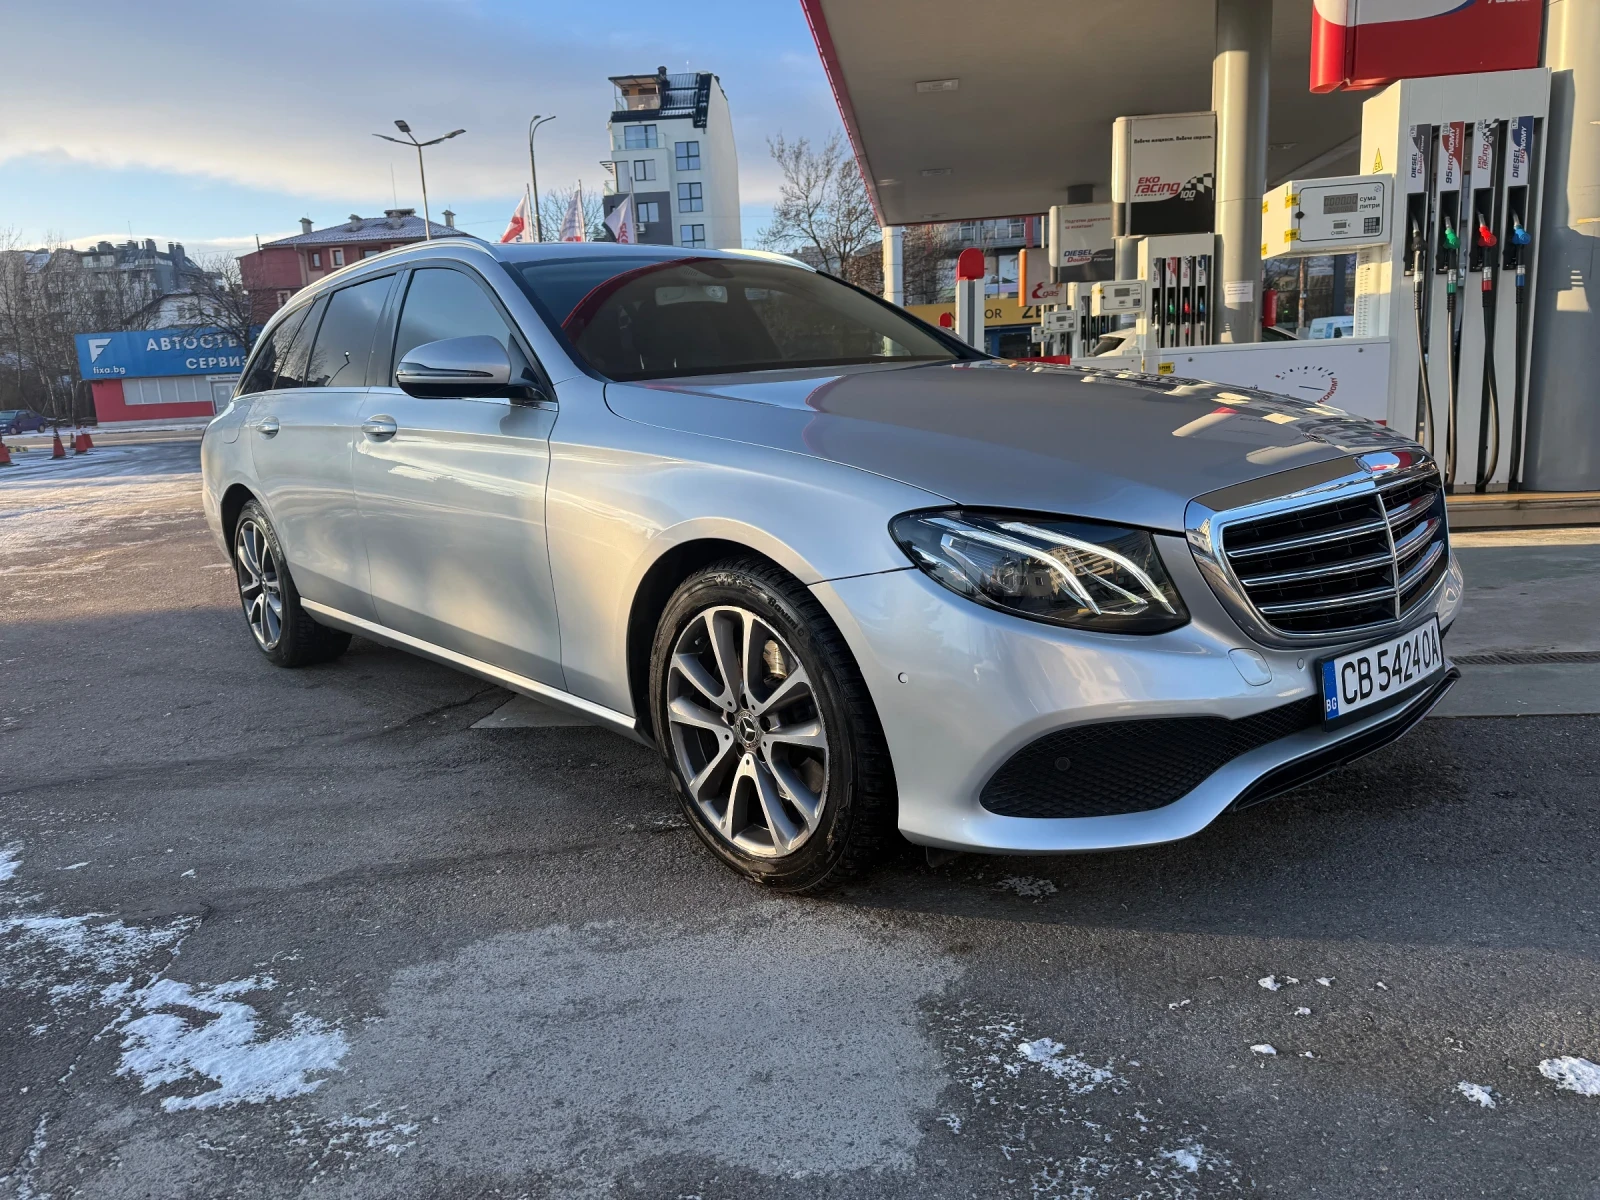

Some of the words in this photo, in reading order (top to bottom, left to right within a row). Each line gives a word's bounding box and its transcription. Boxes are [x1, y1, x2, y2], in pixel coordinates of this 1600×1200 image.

[1448, 127, 1456, 171] EKONOMY
[1482, 144, 1490, 170] racing
[1512, 148, 1520, 178] DIESEL
[1138, 176, 1160, 184] EKO
[1446, 171, 1453, 184] 95
[1135, 182, 1181, 195] racing
[1180, 190, 1196, 199] 100
[1359, 195, 1377, 203] сума
[1064, 249, 1093, 257] DIESEL
[1067, 255, 1092, 263] Double
[93, 366, 126, 374] fixa.bg
[767, 596, 799, 630] Barum
[1326, 697, 1337, 712] BG
